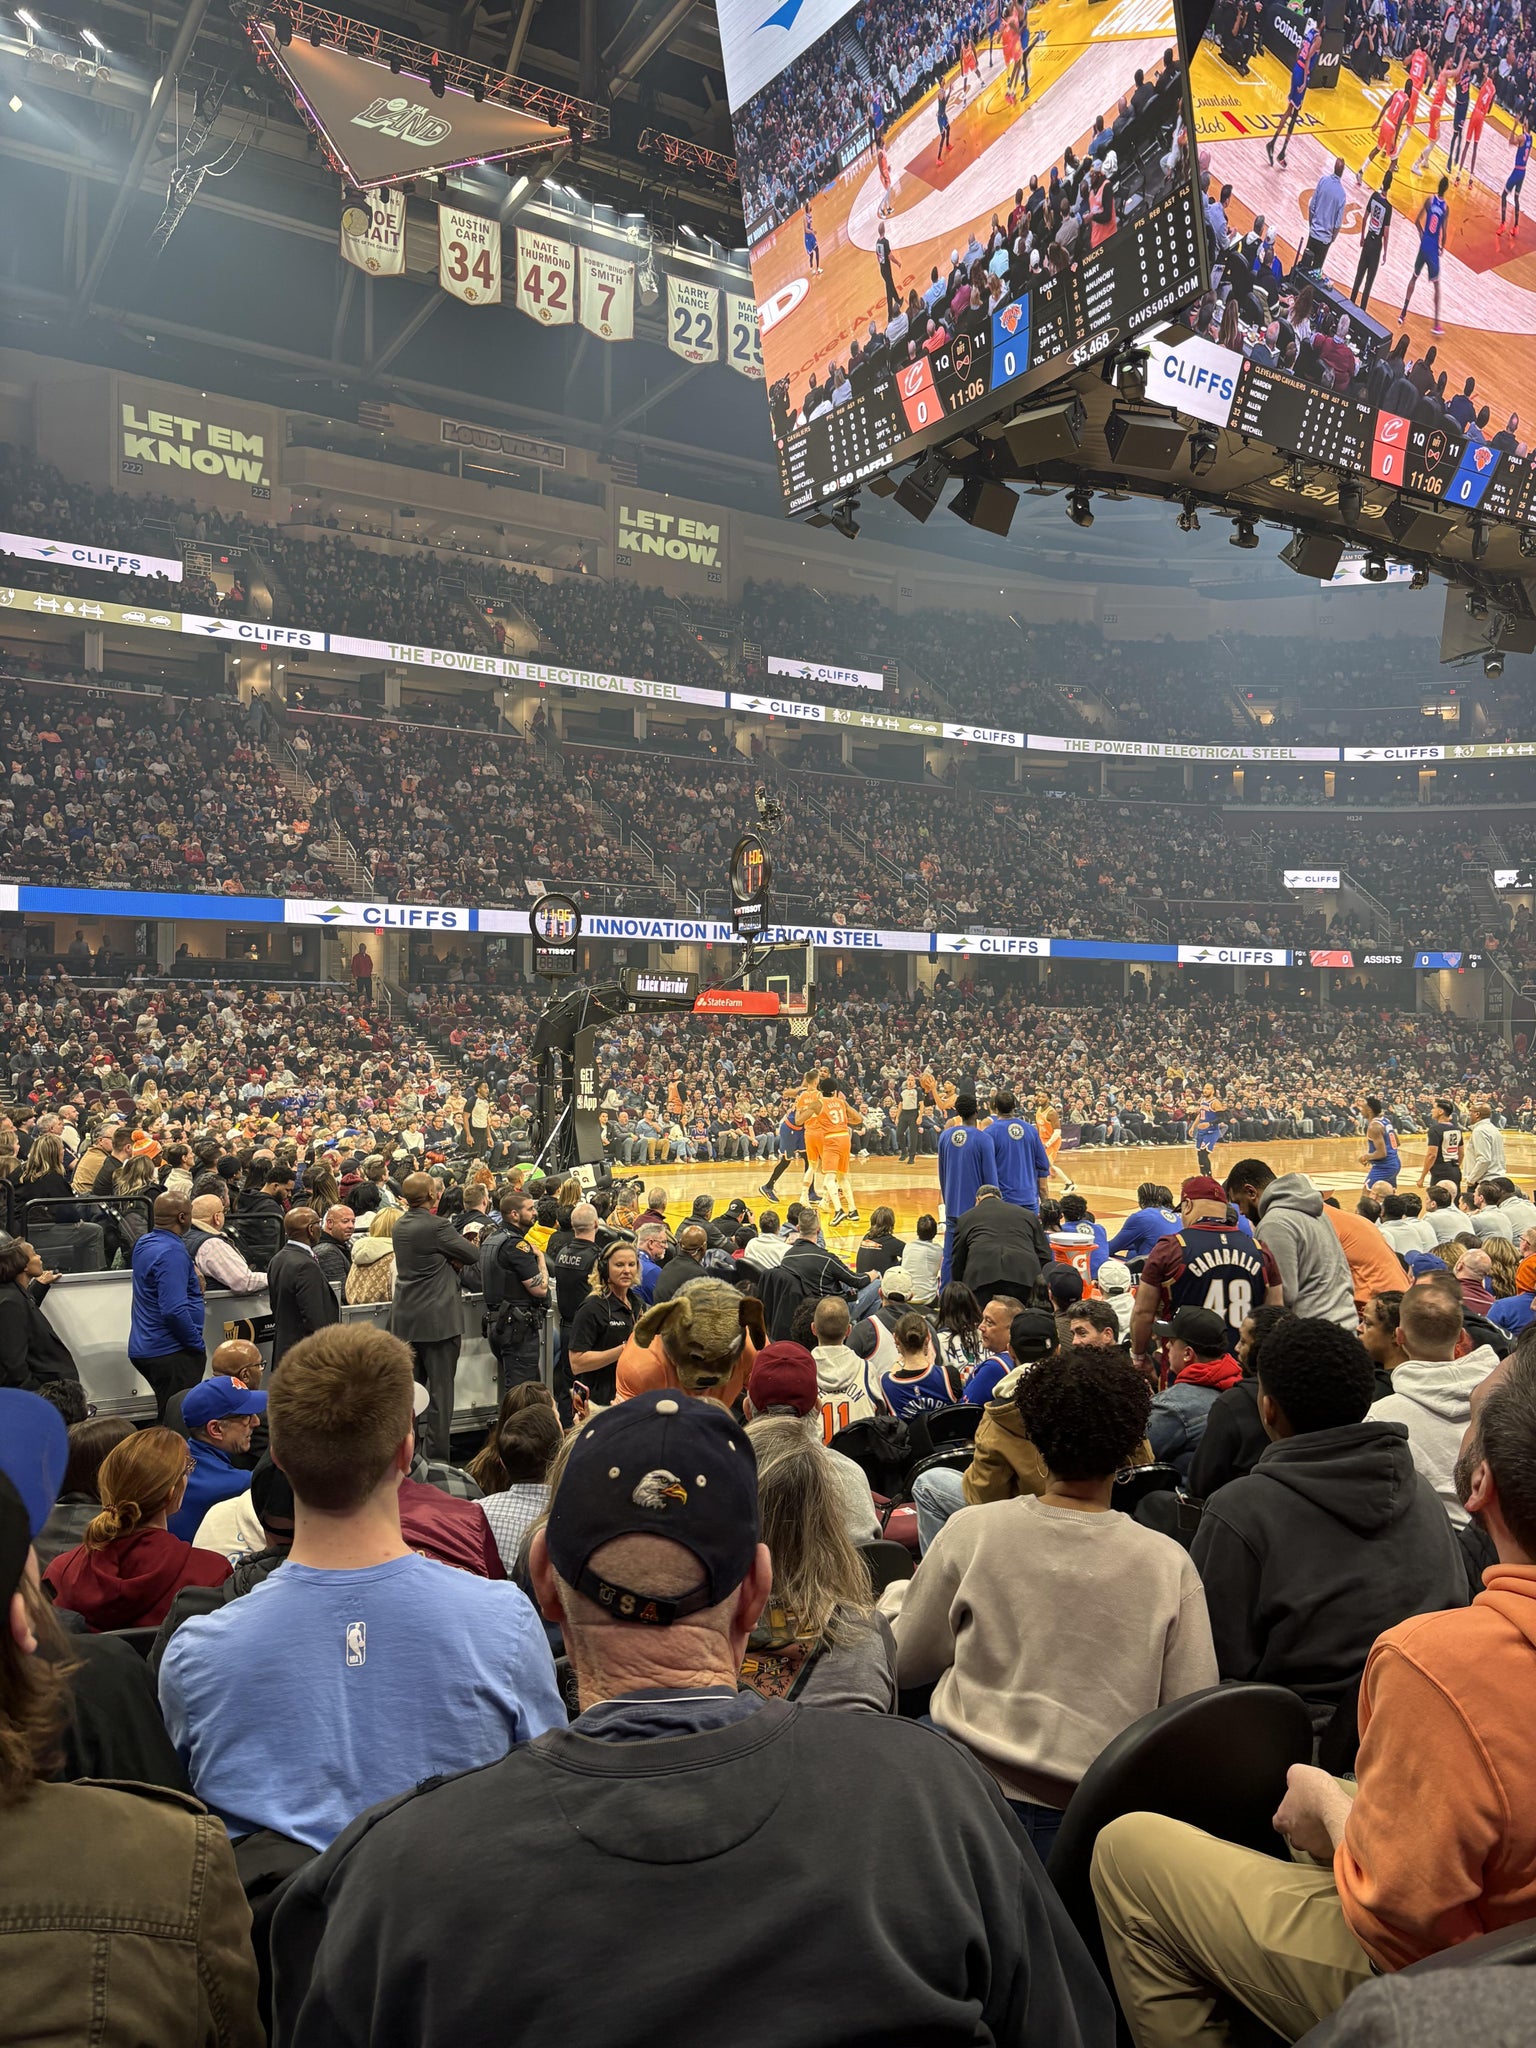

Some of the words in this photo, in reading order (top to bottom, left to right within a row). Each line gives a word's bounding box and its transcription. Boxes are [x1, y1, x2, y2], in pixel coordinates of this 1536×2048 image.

[1274, 15, 1303, 48] coinba
[351, 97, 452, 147] LAND
[1134, 220, 1145, 230] PTS
[1149, 207, 1160, 220] REB
[1164, 196, 1175, 210] AST
[1180, 186, 1190, 198] FLS
[374, 210, 396, 229] OE
[450, 216, 490, 234] AUSTIN
[456, 228, 485, 245] CARR
[1084, 264, 1100, 280] HART
[1138, 234, 1143, 243] 0
[1154, 223, 1158, 231] 1
[1168, 213, 1173, 222] 0
[1184, 201, 1189, 211] 0
[534, 240, 558, 256] NATE
[1082, 246, 1104, 266] KNICKS
[448, 242, 494, 289] 34
[520, 247, 570, 270] THURMOND
[584, 257, 604, 268] BOBBY
[590, 268, 622, 285] SMITH
[1040, 278, 1058, 294] FOULS
[1086, 268, 1114, 292] ANUNOBY
[524, 264, 567, 310] 42
[678, 284, 708, 300] LARRY
[1046, 290, 1052, 300] 0
[1086, 282, 1115, 305] BRUNSON
[1090, 312, 1111, 330] TOWNS
[1143, 288, 1149, 297] 0
[1160, 277, 1166, 286] 0
[1173, 268, 1178, 278] 0
[1189, 257, 1195, 267] 0
[598, 283, 616, 321] 7
[678, 294, 710, 310] NANCE
[738, 301, 758, 314] MAR
[1088, 298, 1112, 318] BRIDGES
[1128, 275, 1199, 328] CAVS5050.COM
[738, 312, 758, 324] PRIC
[674, 307, 713, 350] 22
[733, 324, 764, 364] 25
[974, 332, 986, 348] 11
[1073, 332, 1110, 366] $5,468
[936, 354, 949, 372] 1Q
[1004, 352, 1016, 376] 0
[1164, 356, 1234, 400] CLIFFS
[1254, 366, 1282, 383] CLEVELAND
[950, 378, 984, 410] 11:06
[917, 402, 927, 423] 0
[122, 404, 201, 442] LET
[208, 424, 264, 458] EM
[1413, 432, 1425, 446] 1Q
[124, 432, 270, 486] KNOW.
[1449, 444, 1460, 457] 11
[123, 462, 142, 474] 222
[856, 452, 894, 478] RAFFLE
[1382, 454, 1393, 474] 0
[1410, 471, 1442, 494] 11:06
[1460, 480, 1472, 500] 0
[252, 488, 270, 498] 223
[619, 506, 674, 534] LET
[678, 518, 720, 544] EM
[618, 529, 722, 568] KNOW.
[72, 549, 141, 570] CLIFFS
[238, 625, 312, 646] CLIFFS
[388, 645, 424, 664] THE
[431, 650, 496, 674] POWER
[502, 660, 520, 677] IN
[526, 666, 628, 692] ELECTRICAL
[634, 680, 682, 700] STEEL
[818, 669, 859, 682] CLIFFS
[770, 701, 820, 718] CLIFFS
[972, 730, 1016, 744] CLIFFS
[1064, 740, 1090, 752] THE
[1094, 742, 1142, 754] POWER
[1147, 744, 1160, 756] IN
[1164, 745, 1248, 758] ELECTRICAL
[1252, 748, 1296, 759] STEEL
[1384, 748, 1439, 758] CLIFFS
[1304, 875, 1338, 884] CLIFFS
[364, 908, 457, 928] CLIFFS
[741, 904, 762, 914] TISSOT
[590, 918, 710, 939] INNOVATION
[714, 925, 730, 940] IN
[833, 932, 882, 946] STEEL
[548, 948, 576, 956] TISSOT
[980, 939, 1038, 954] CLIFFS
[1218, 950, 1273, 964] CLIFFS
[1342, 954, 1349, 964] 0
[1364, 955, 1402, 964] ASSISTS
[1422, 956, 1428, 965] 0
[636, 980, 658, 992] BLACK
[660, 982, 688, 994] HISTORY
[580, 1068, 594, 1081] GET
[580, 1082, 594, 1094] THE
[582, 1095, 598, 1111] App
[830, 1110, 844, 1124] 31
[560, 1254, 582, 1266] POLICE
[1072, 1254, 1086, 1272] G
[1188, 1248, 1260, 1278] CARABALLO
[1203, 1279, 1252, 1328] 48
[822, 1402, 850, 1446] 11
